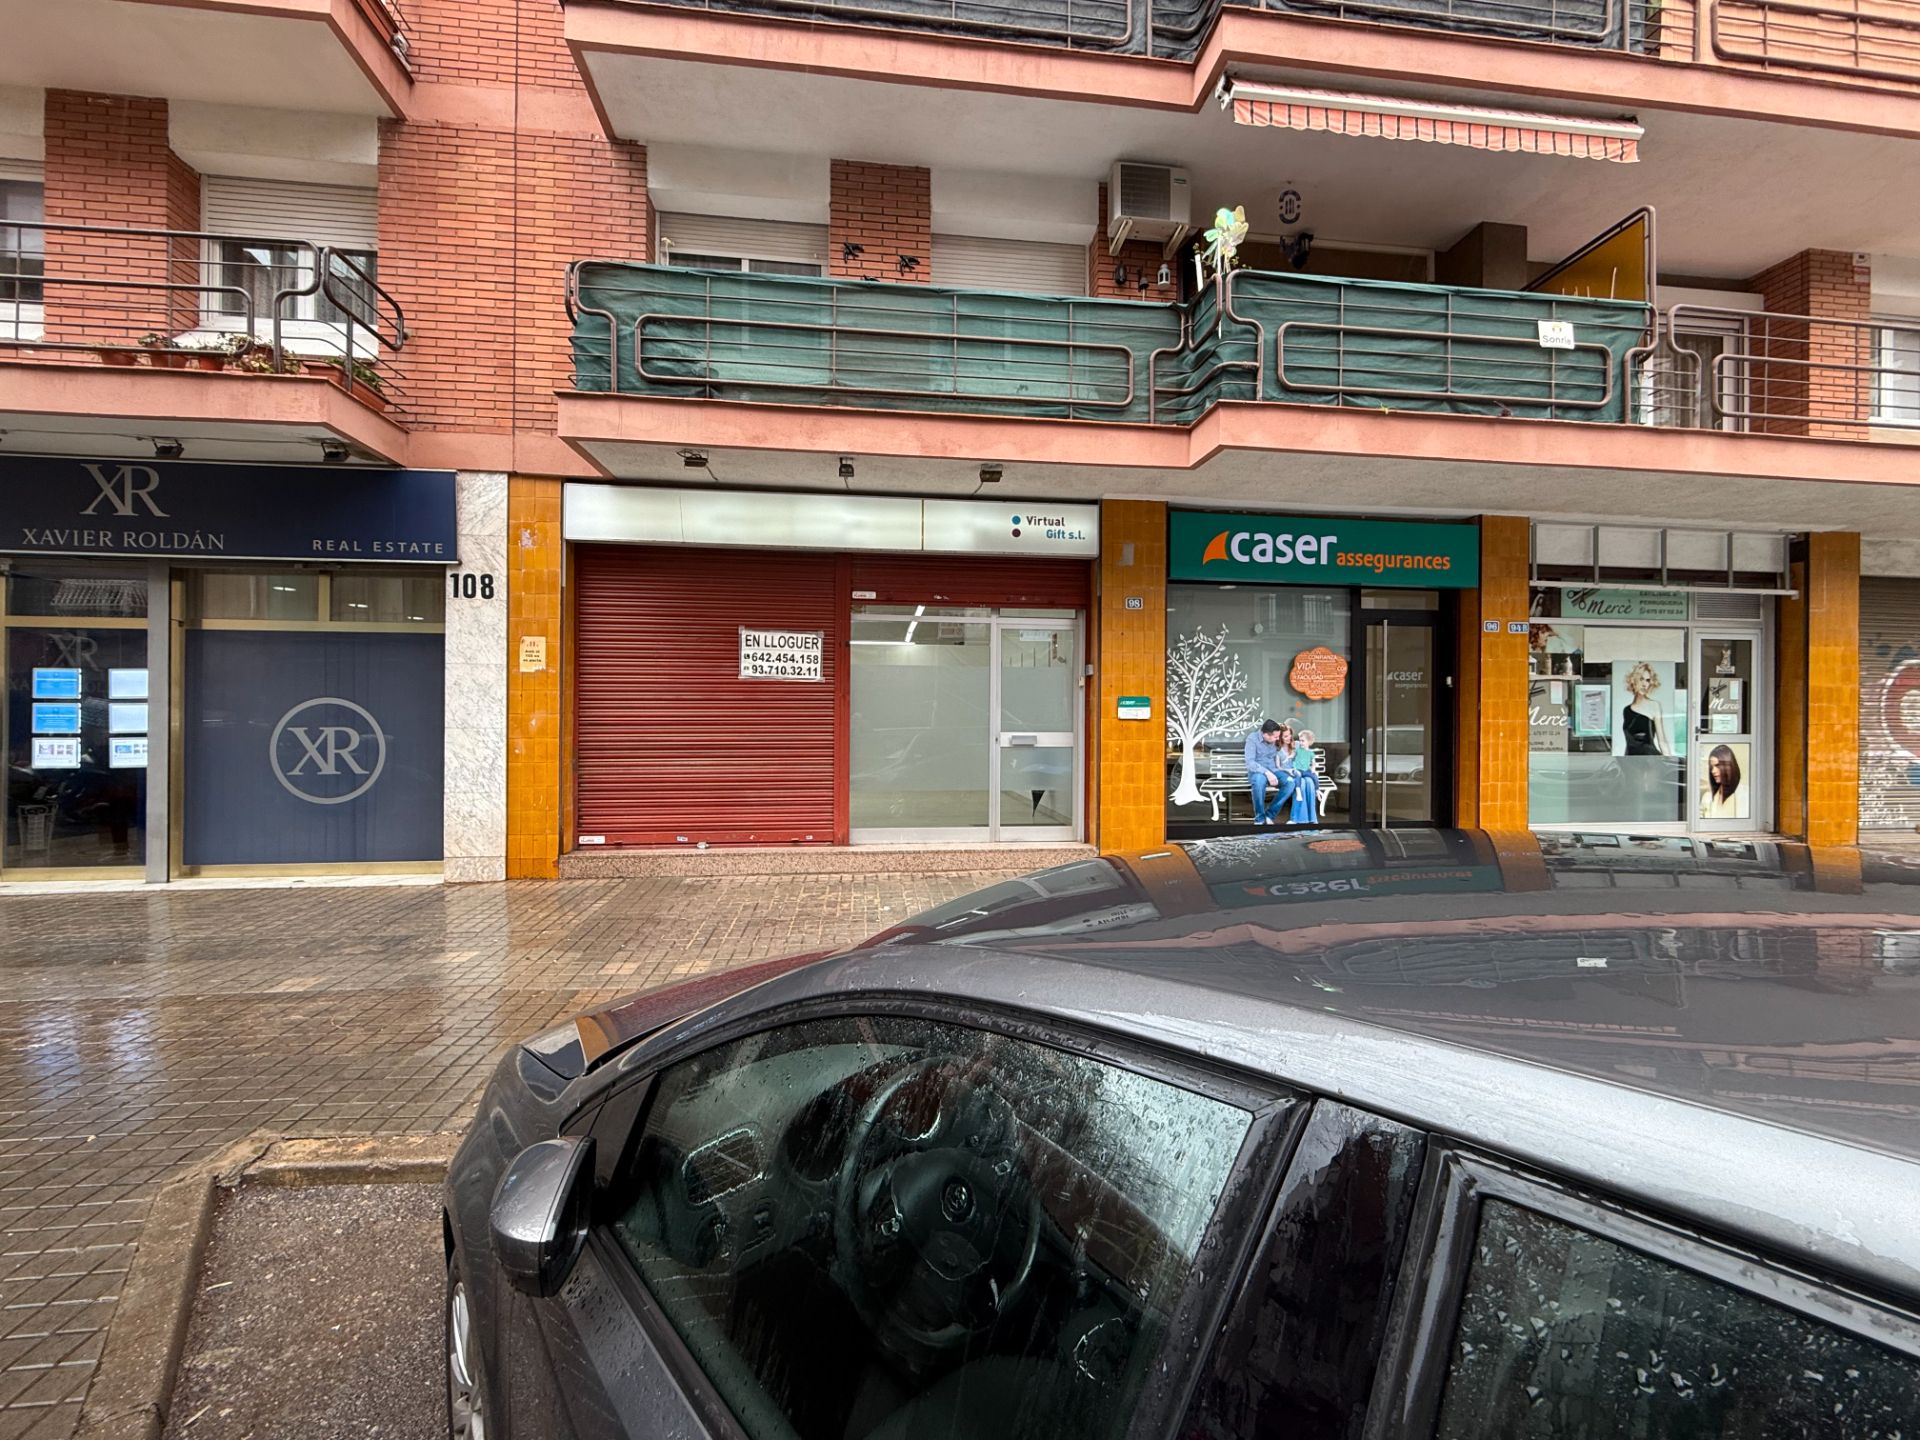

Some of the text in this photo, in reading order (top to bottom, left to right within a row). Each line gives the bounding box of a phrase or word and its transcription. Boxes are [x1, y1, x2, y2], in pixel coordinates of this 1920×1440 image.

[79, 463, 171, 517] XR
[1026, 516, 1065, 526] Virtual
[22, 529, 224, 550] XAVIER ROLDÁN
[1046, 529, 1086, 540] Gift s.l.
[313, 539, 443, 554] REAL ESTATE
[1230, 532, 1451, 573] caser assegurances
[450, 573, 494, 599] 108
[1128, 600, 1140, 608] 98
[1587, 599, 1633, 615] Mercè
[1486, 622, 1497, 630] 96
[745, 634, 819, 649] EN LLOGUER
[751, 652, 819, 664] 642.454.158
[751, 665, 818, 676] 93.710.32.11
[1297, 662, 1316, 670] VIDA
[1393, 671, 1423, 681] caser
[286, 726, 370, 775] XR
